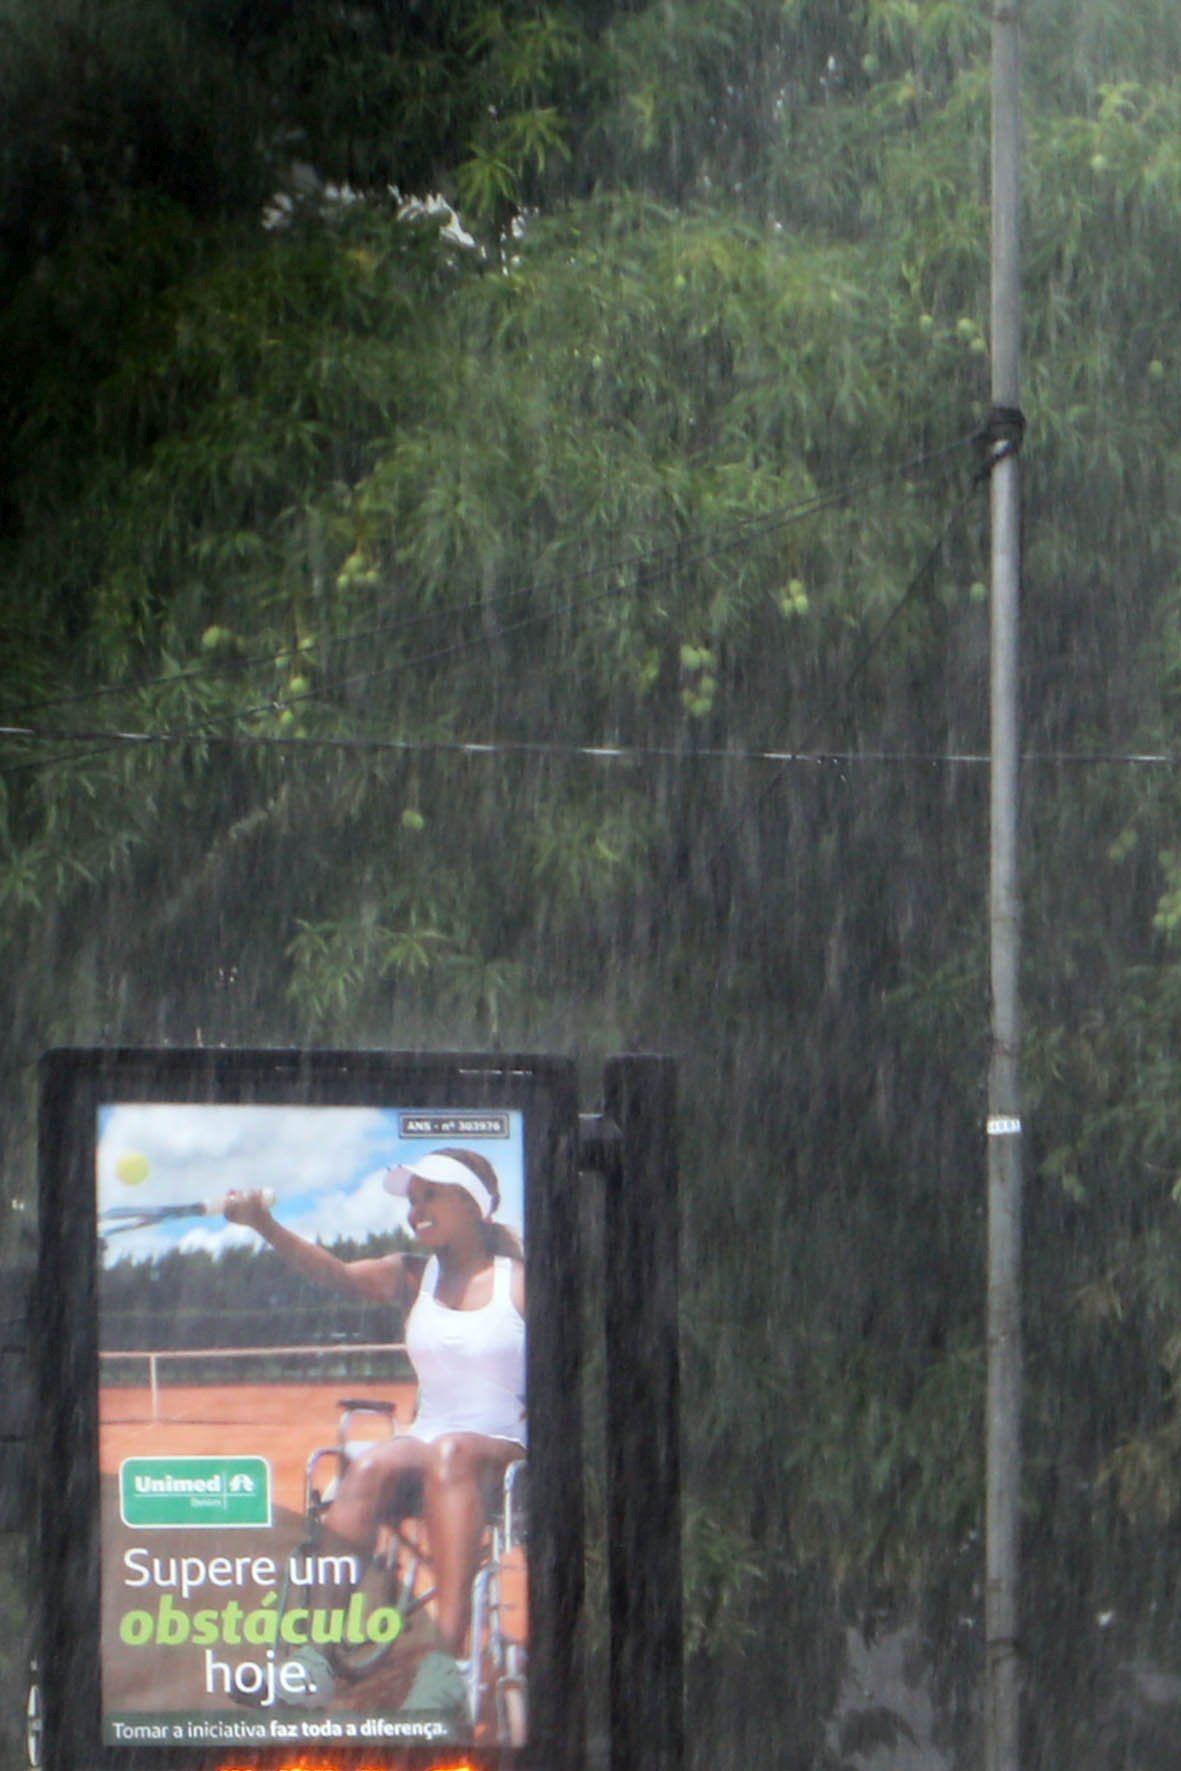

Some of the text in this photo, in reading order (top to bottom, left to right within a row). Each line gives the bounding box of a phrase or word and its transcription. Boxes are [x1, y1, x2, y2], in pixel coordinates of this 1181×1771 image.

[407, 1120, 432, 1131] ANS
[134, 1475, 221, 1492] Unimed
[123, 1548, 358, 1598] Supere um
[119, 1591, 402, 1645] obstáculo
[205, 1650, 317, 1706] hoje.
[112, 1719, 448, 1740] Tomar a iniciativa faz toda a diferença.
